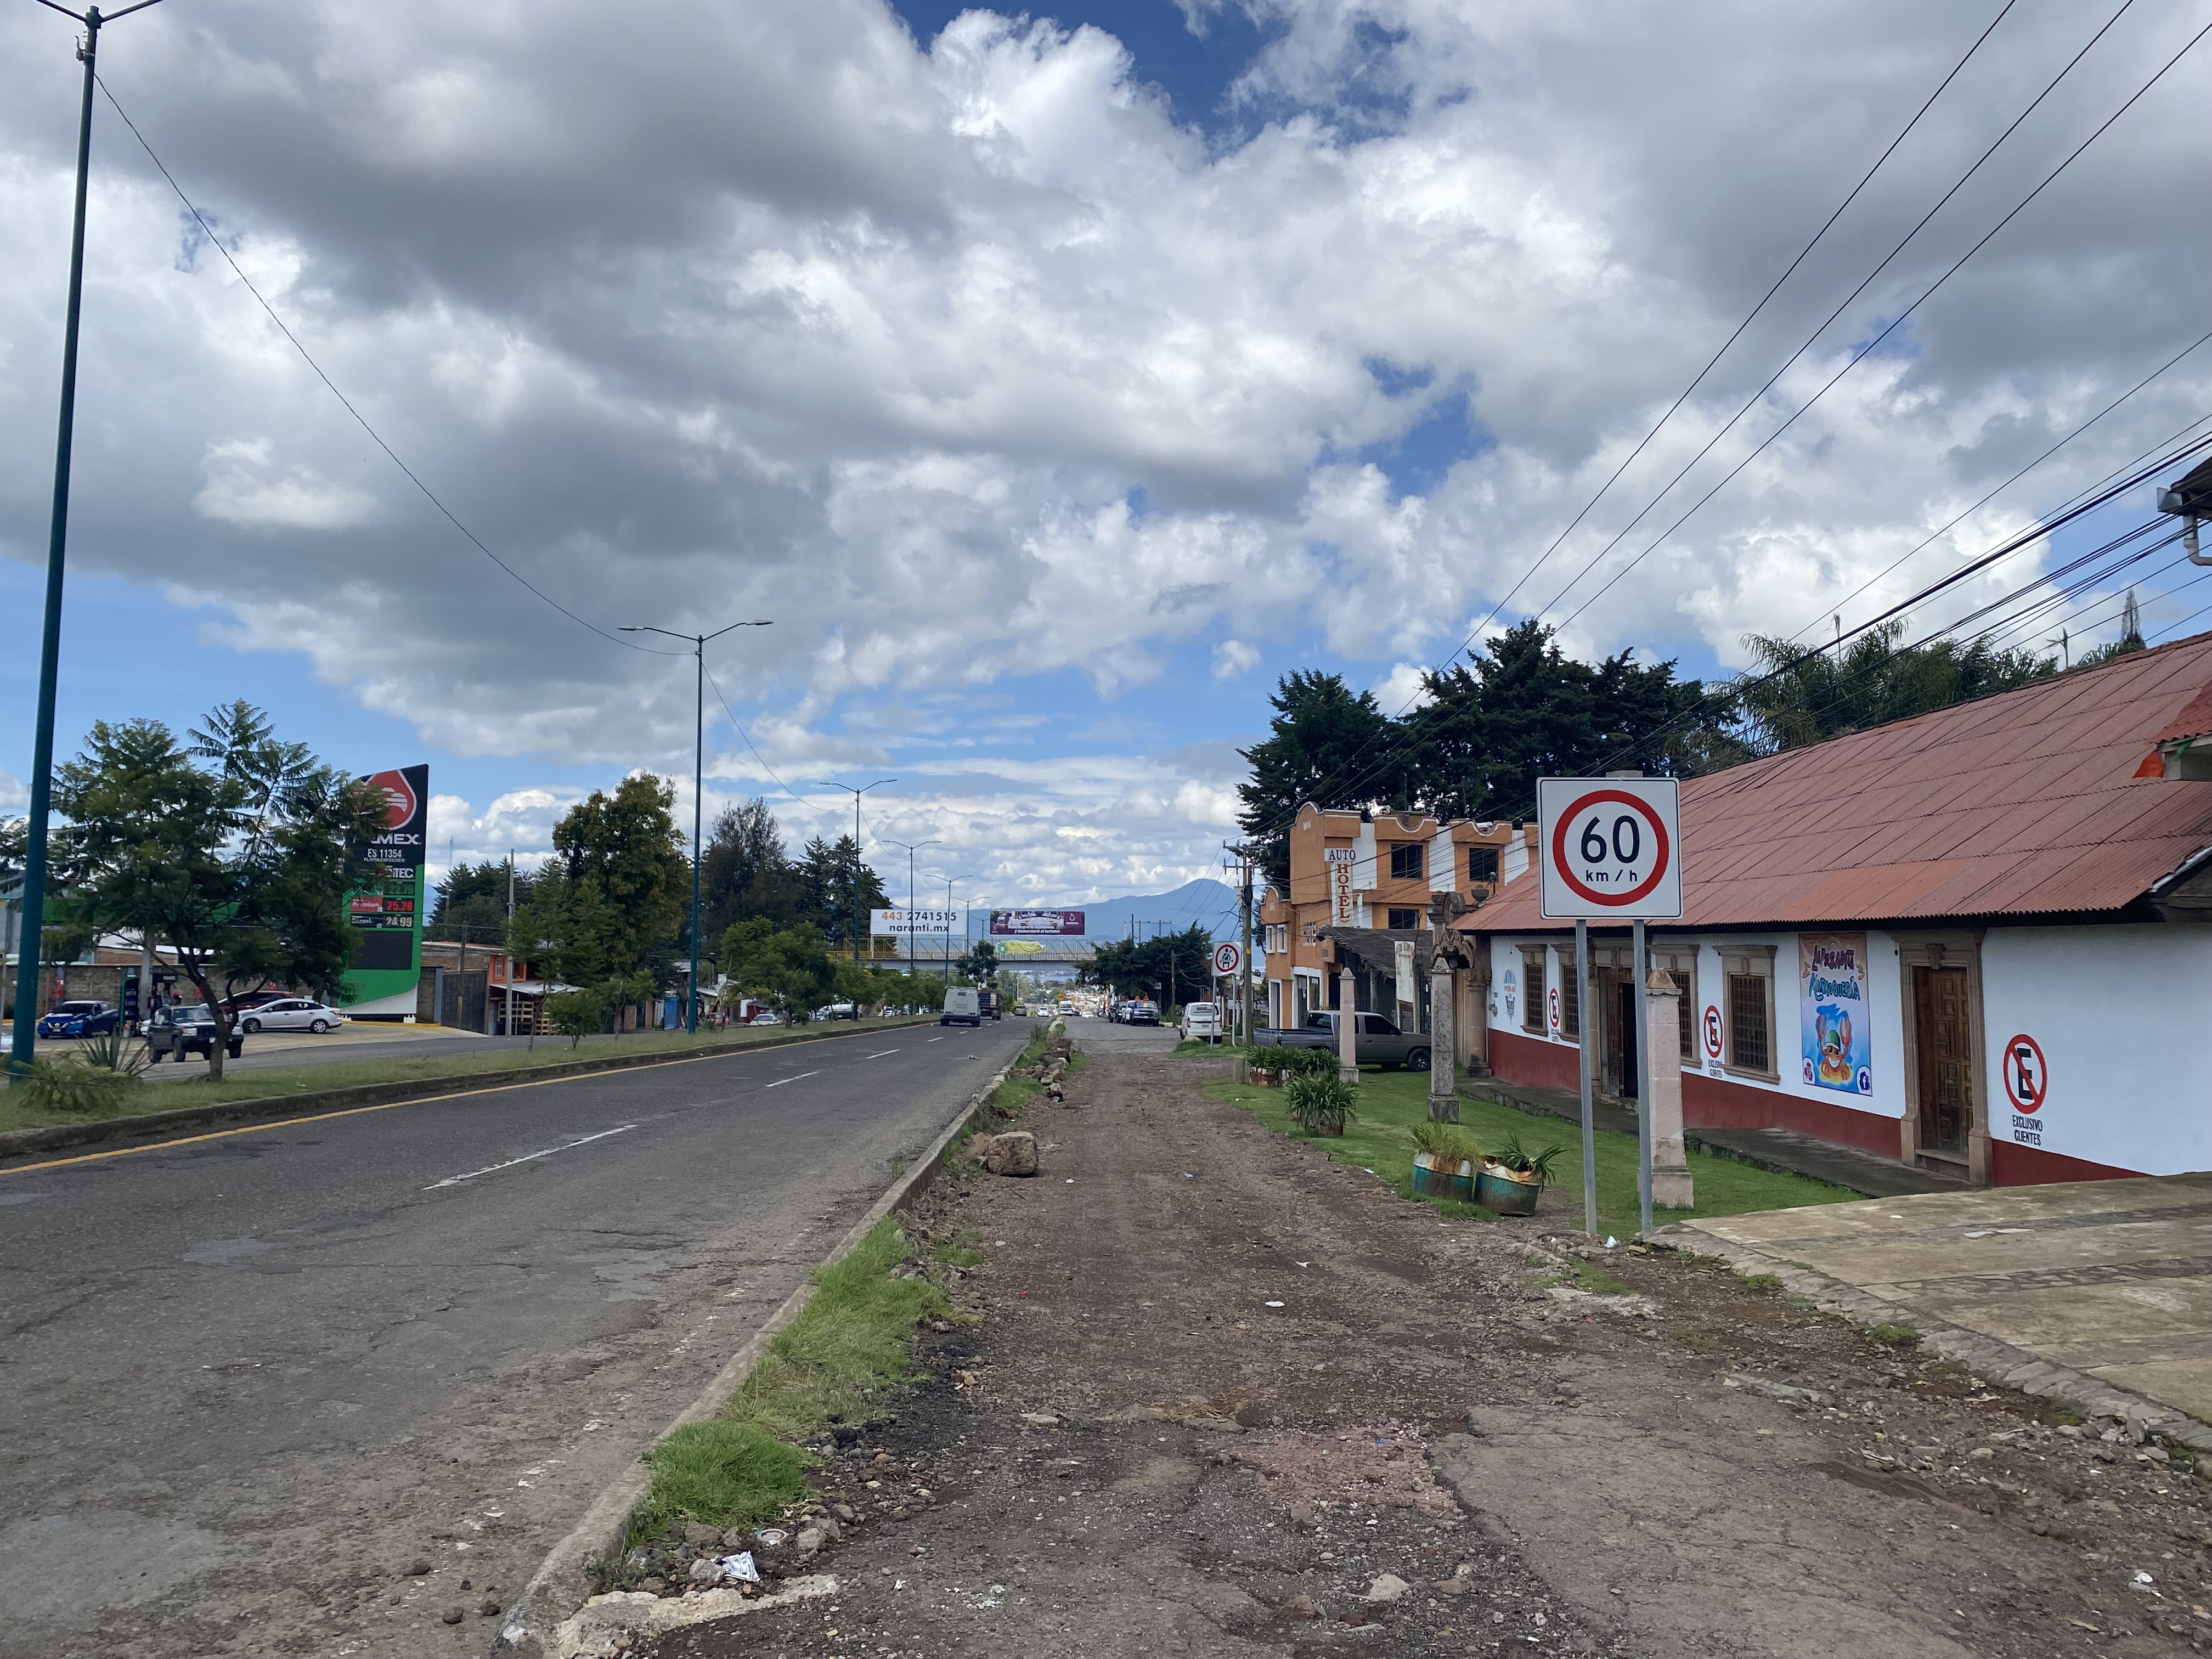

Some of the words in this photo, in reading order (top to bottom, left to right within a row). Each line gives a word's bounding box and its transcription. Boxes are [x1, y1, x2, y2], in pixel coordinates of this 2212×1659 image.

[353, 833, 419, 845] MEX
[1581, 815, 1640, 864] 60
[368, 848, 377, 857] ES
[380, 849, 402, 858] 11354
[1329, 850, 1356, 860] AUTO
[1337, 864, 1350, 918] HOTEL
[387, 901, 413, 911] 25.20
[882, 912, 902, 920] 443
[907, 912, 956, 921] 2741515
[889, 923, 949, 932] naranti.mx
[2017, 1048, 2033, 1100] E
[2012, 1115, 2042, 1132] EXCLUSIVO
[2015, 1130, 2041, 1146] CLIENTES
